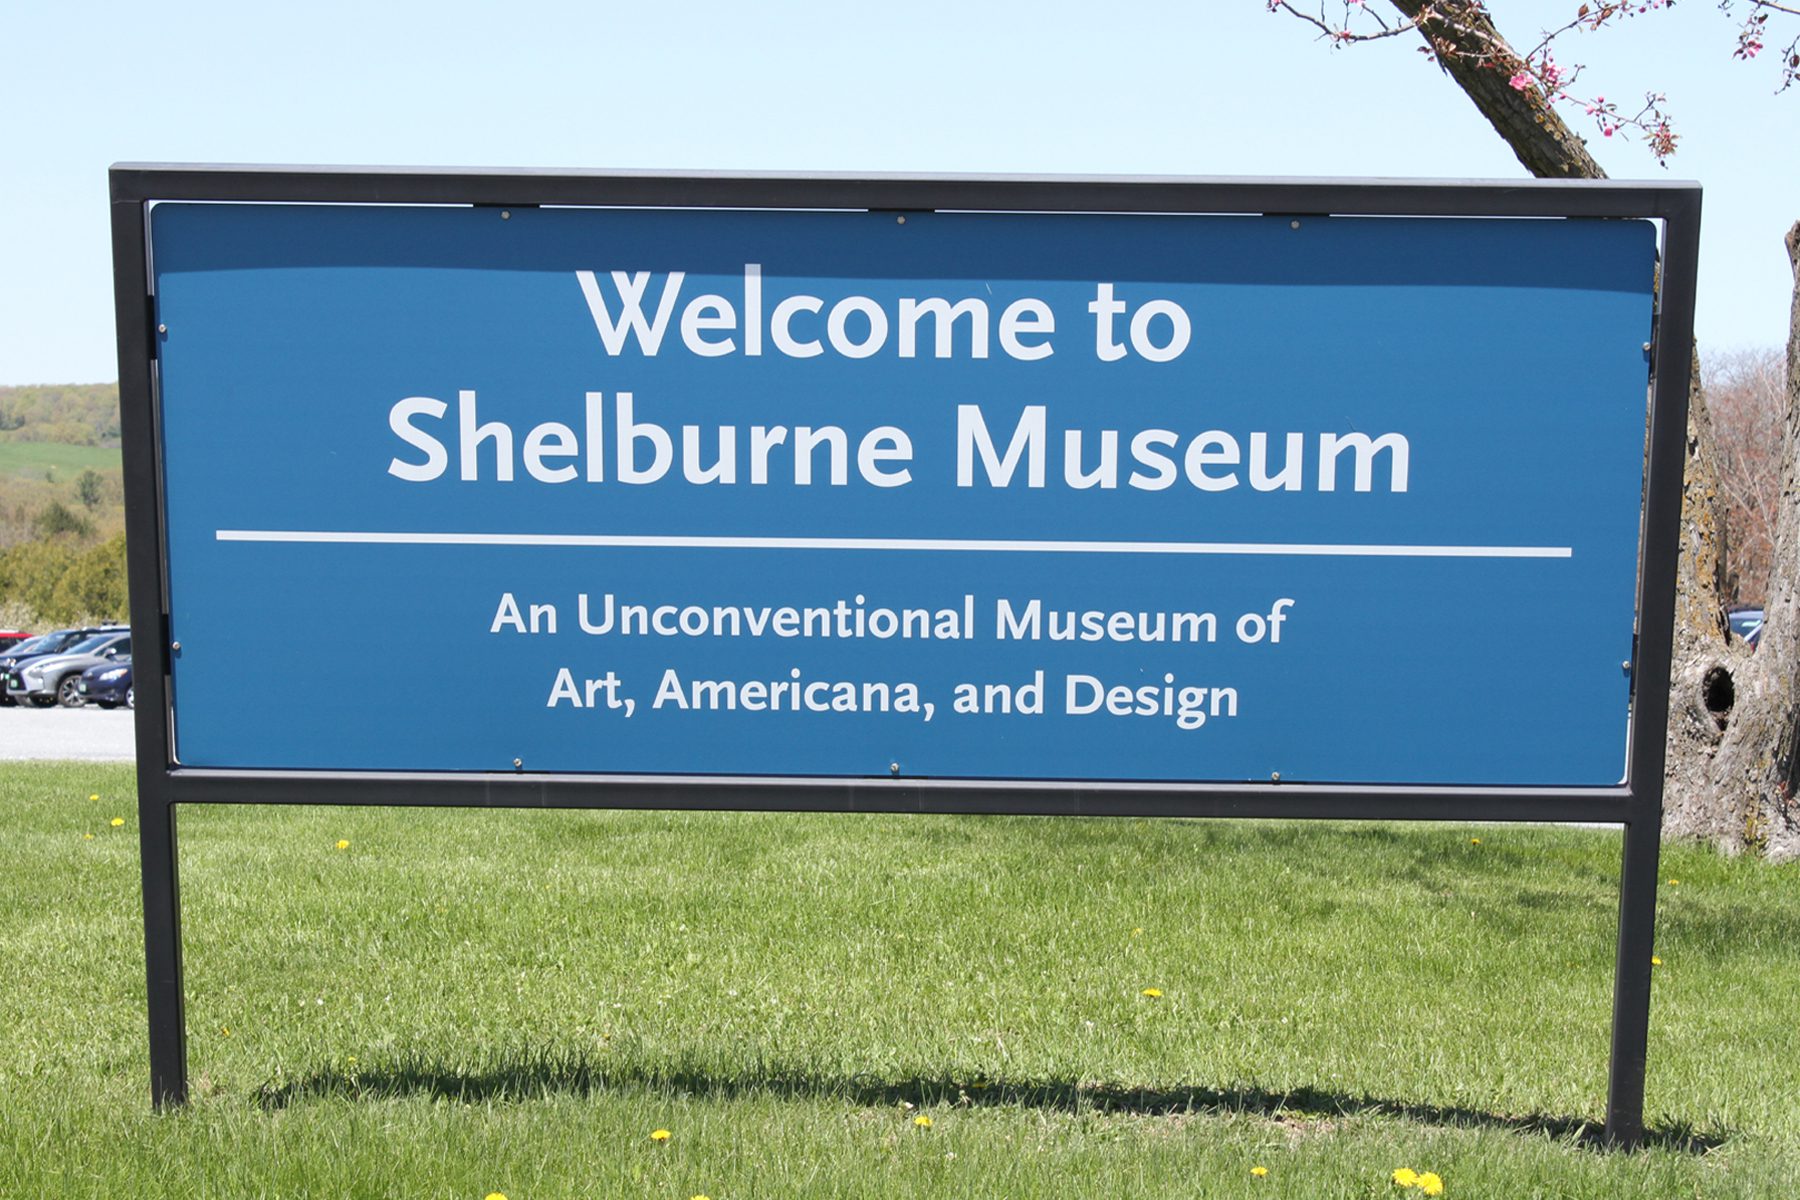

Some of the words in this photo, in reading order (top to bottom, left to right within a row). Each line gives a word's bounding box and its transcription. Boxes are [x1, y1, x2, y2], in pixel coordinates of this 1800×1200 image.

[575, 263, 1056, 361] Welcome
[1087, 282, 1192, 363] to
[387, 389, 914, 488] Shelburne
[956, 404, 1410, 493] Museum
[490, 592, 557, 634] An
[578, 593, 974, 640] Unconventional
[996, 598, 1217, 643] Museum
[1235, 598, 1296, 644] of
[546, 667, 636, 718] Art,
[652, 667, 935, 722] Americana,
[953, 670, 1044, 715] and
[1065, 672, 1238, 730] Design
